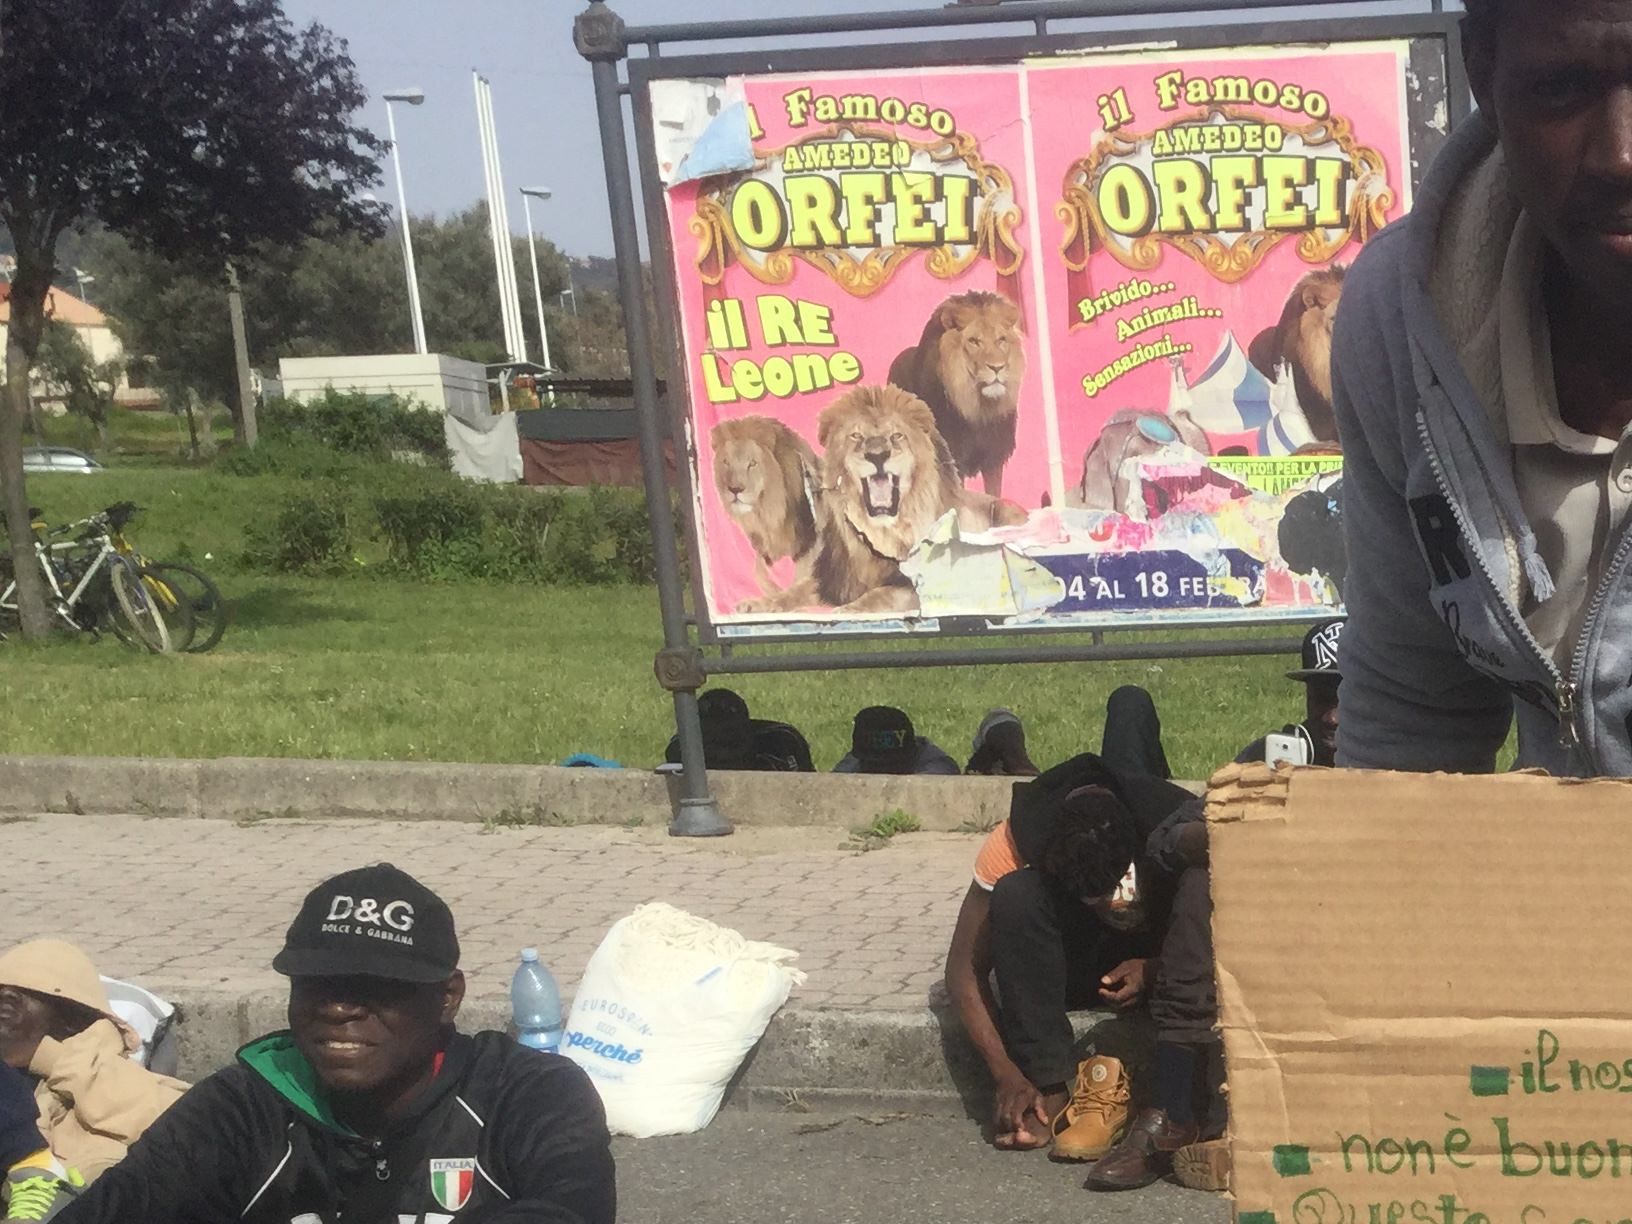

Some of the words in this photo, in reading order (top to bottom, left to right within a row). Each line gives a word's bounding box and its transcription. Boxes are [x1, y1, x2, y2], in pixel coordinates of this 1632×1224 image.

[783, 88, 957, 138] Famoso
[1097, 86, 1134, 131] il
[1153, 70, 1331, 120] Famoso
[783, 140, 912, 172] AMEDEO
[1151, 123, 1285, 157] AMEDEO
[731, 171, 980, 251] ORFEI
[1097, 155, 1352, 239] ORFEI
[706, 297, 750, 350] il
[756, 294, 839, 347] RE
[1076, 278, 1175, 322] Brivido...
[1115, 296, 1223, 342] Animali...
[700, 351, 864, 404] Leone
[1276, 462, 1299, 475] PER
[1097, 577, 1125, 599] AL
[1135, 571, 1169, 598] 18
[326, 895, 415, 932] D&G
[1518, 1029, 1560, 1095] il
[433, 1159, 472, 1170] ITALIA
